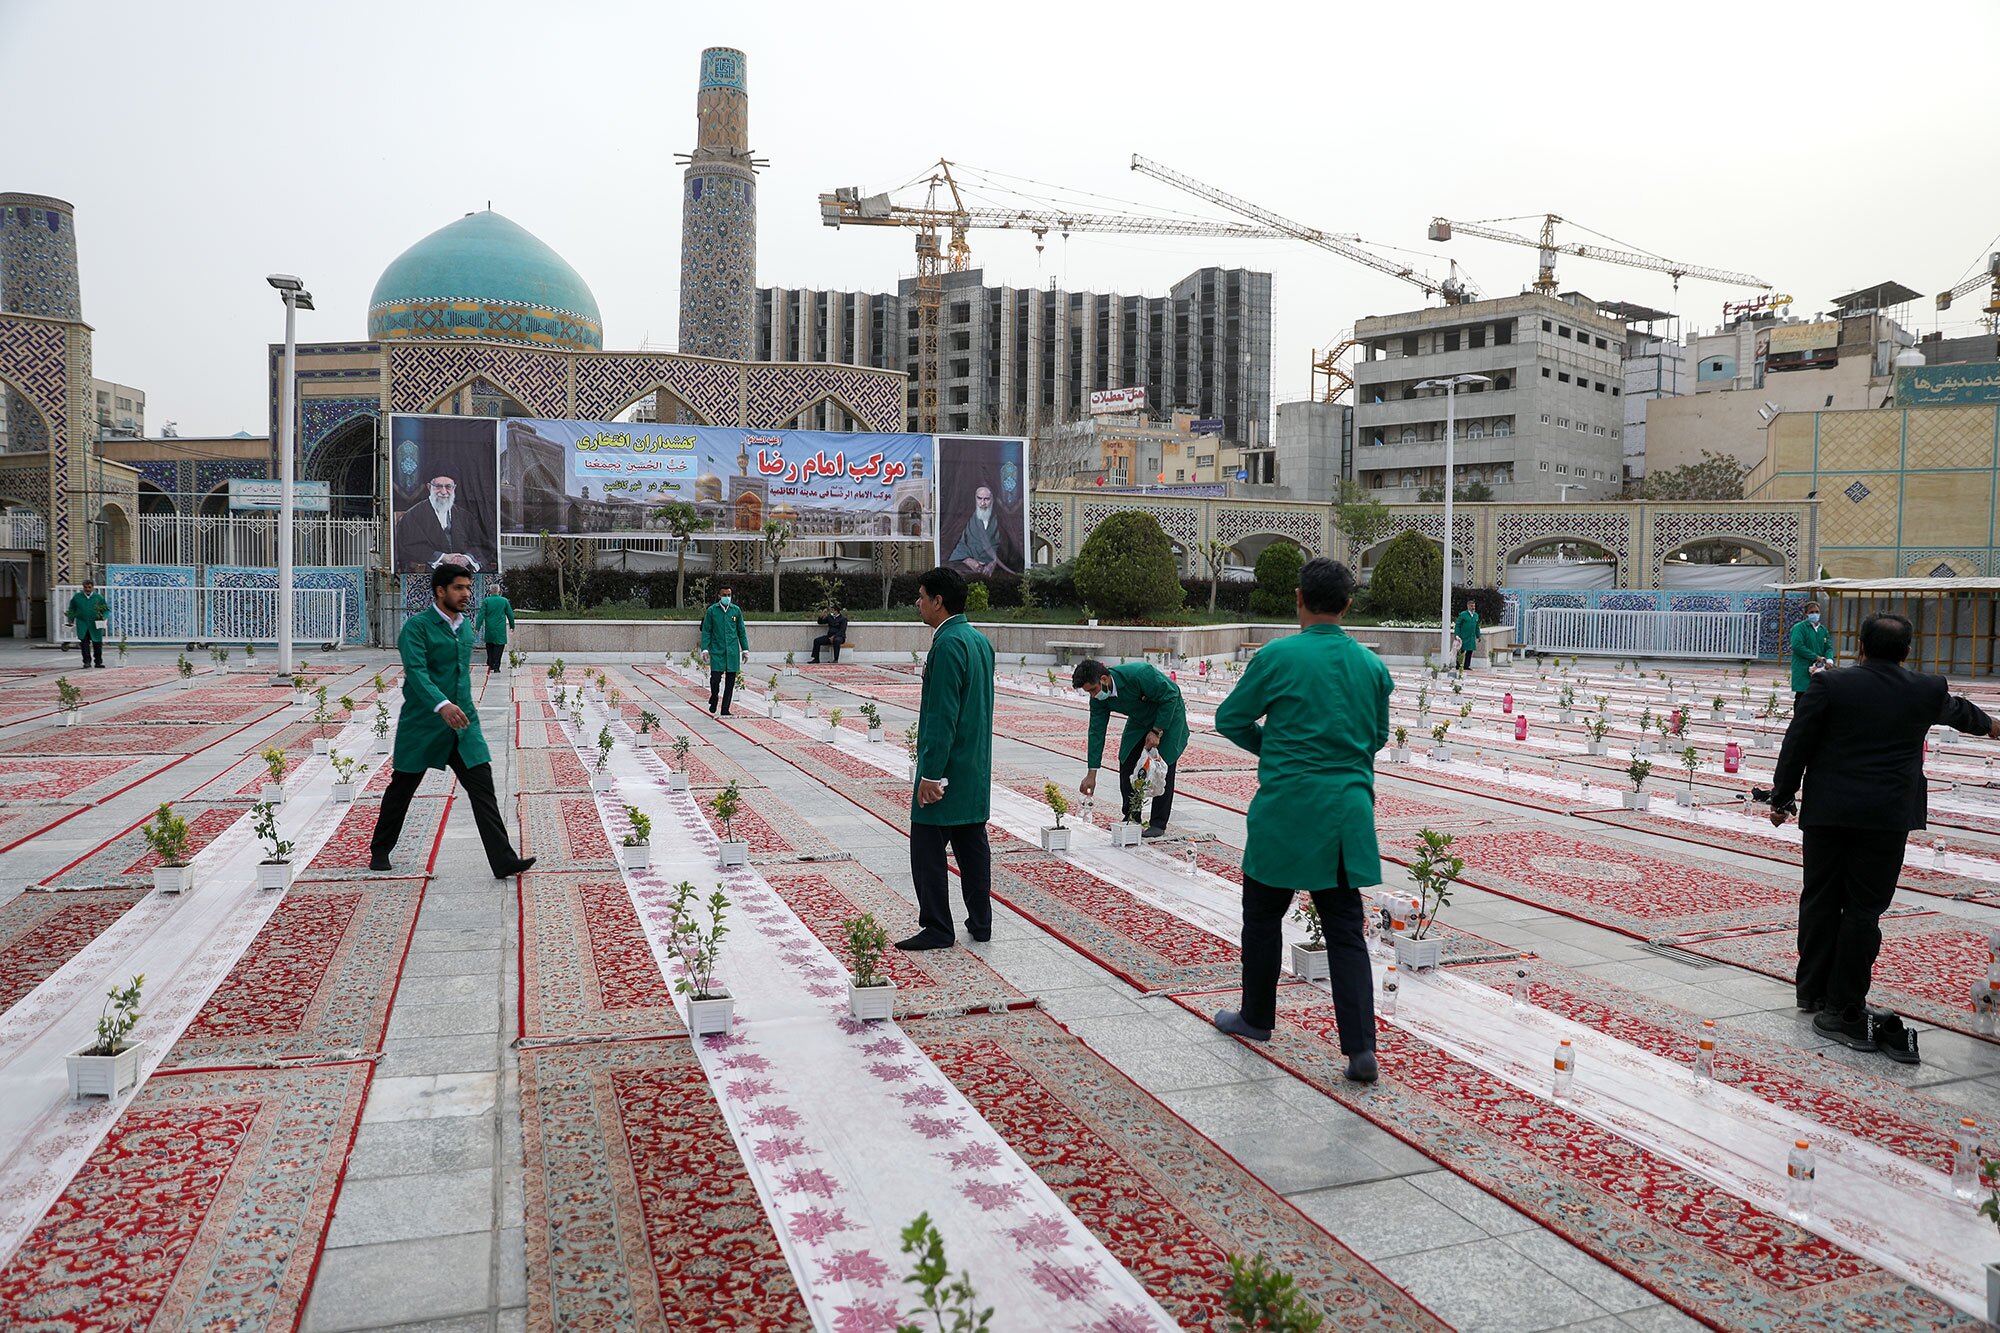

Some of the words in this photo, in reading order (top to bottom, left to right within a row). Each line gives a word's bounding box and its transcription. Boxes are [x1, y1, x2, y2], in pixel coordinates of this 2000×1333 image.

[1767, 293, 1793, 310] هتل
[1092, 390, 1125, 405] تعطیلات
[1128, 387, 1145, 402] هتل
[576, 432, 631, 451] افتخاری
[632, 434, 697, 453] کفشداران
[757, 449, 798, 483] رضا
[802, 450, 845, 482] امام
[848, 452, 906, 485] موکب
[629, 479, 642, 492] شهر
[647, 481, 657, 493] در
